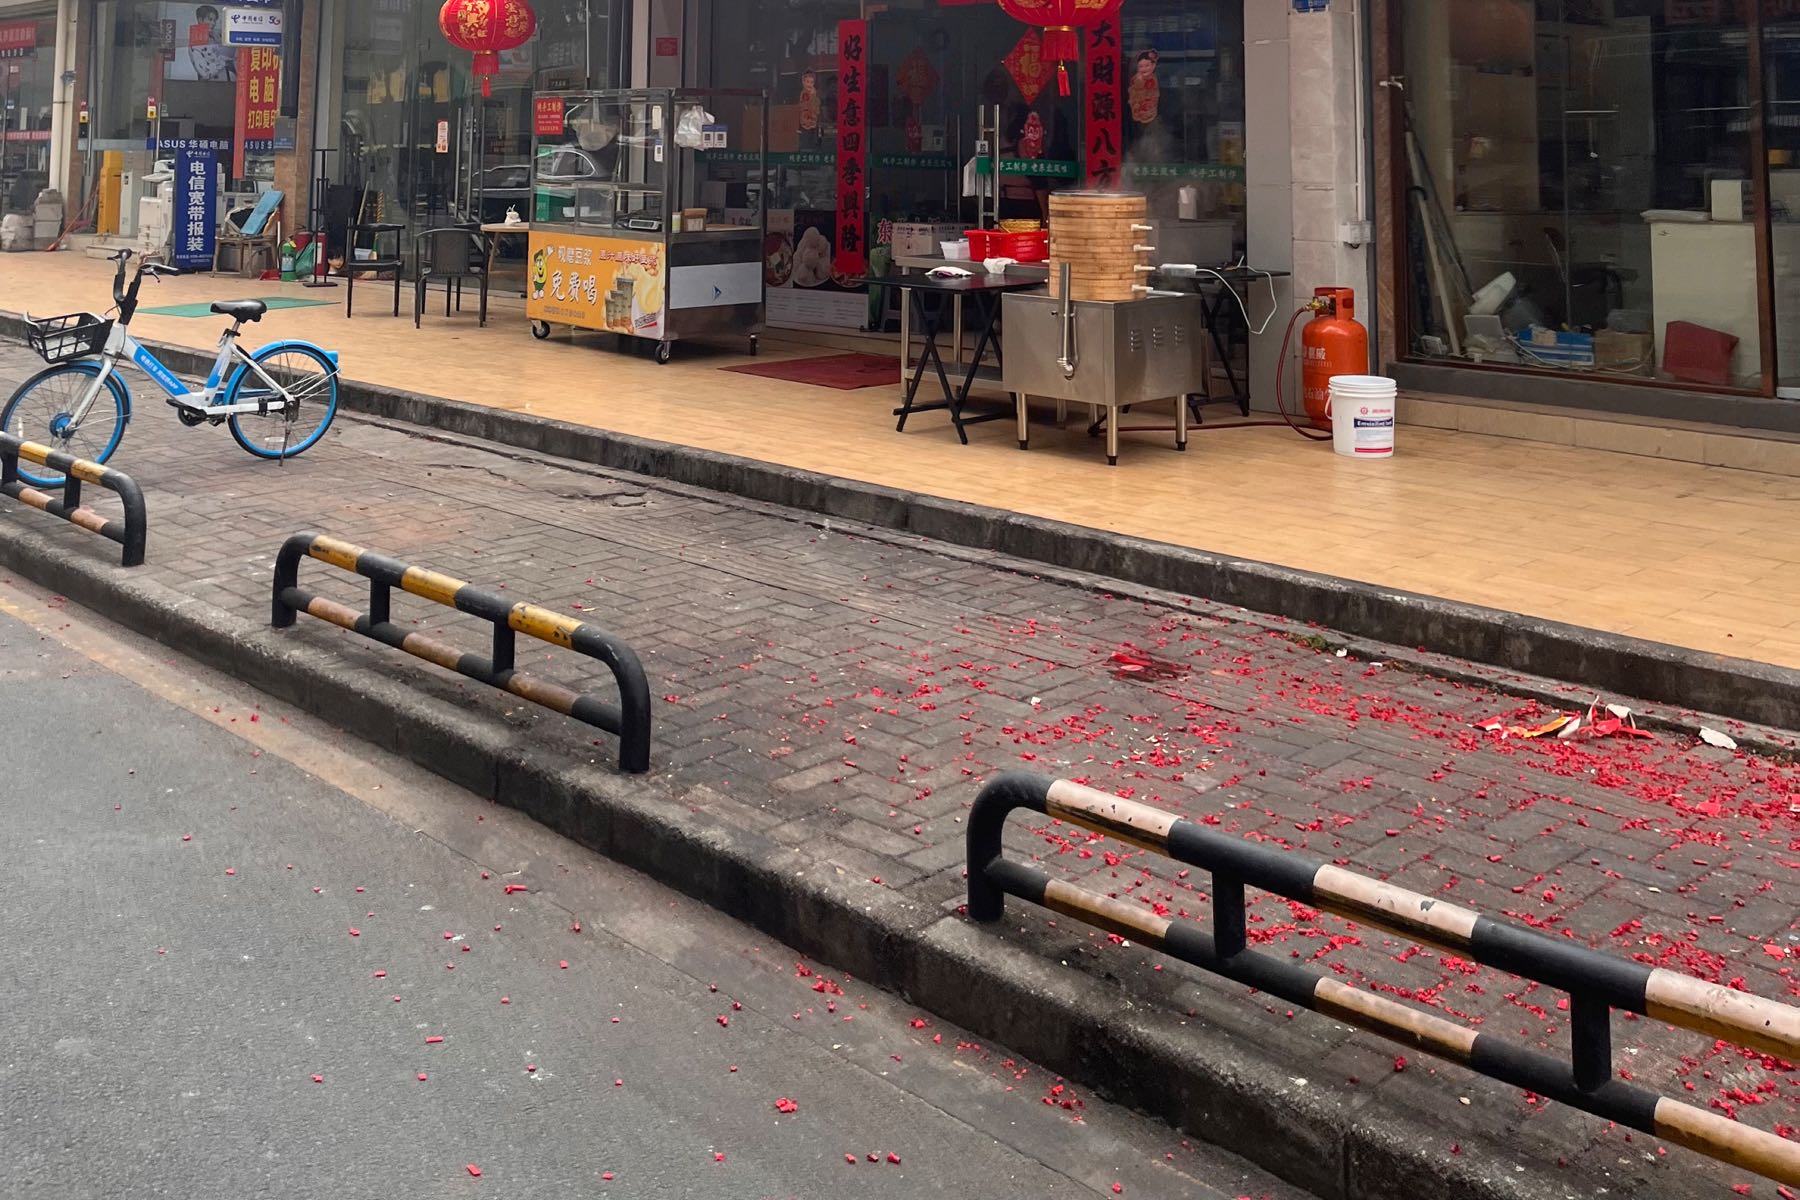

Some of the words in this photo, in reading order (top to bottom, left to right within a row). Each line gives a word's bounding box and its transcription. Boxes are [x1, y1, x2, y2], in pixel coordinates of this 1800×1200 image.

[250, 76, 275, 104] 电脑
[189, 140, 229, 150] 华硕电脑
[841, 34, 862, 252] 好生意四季興隆
[187, 160, 207, 252] 电信宽带报装
[550, 270, 597, 305] 免费喝
